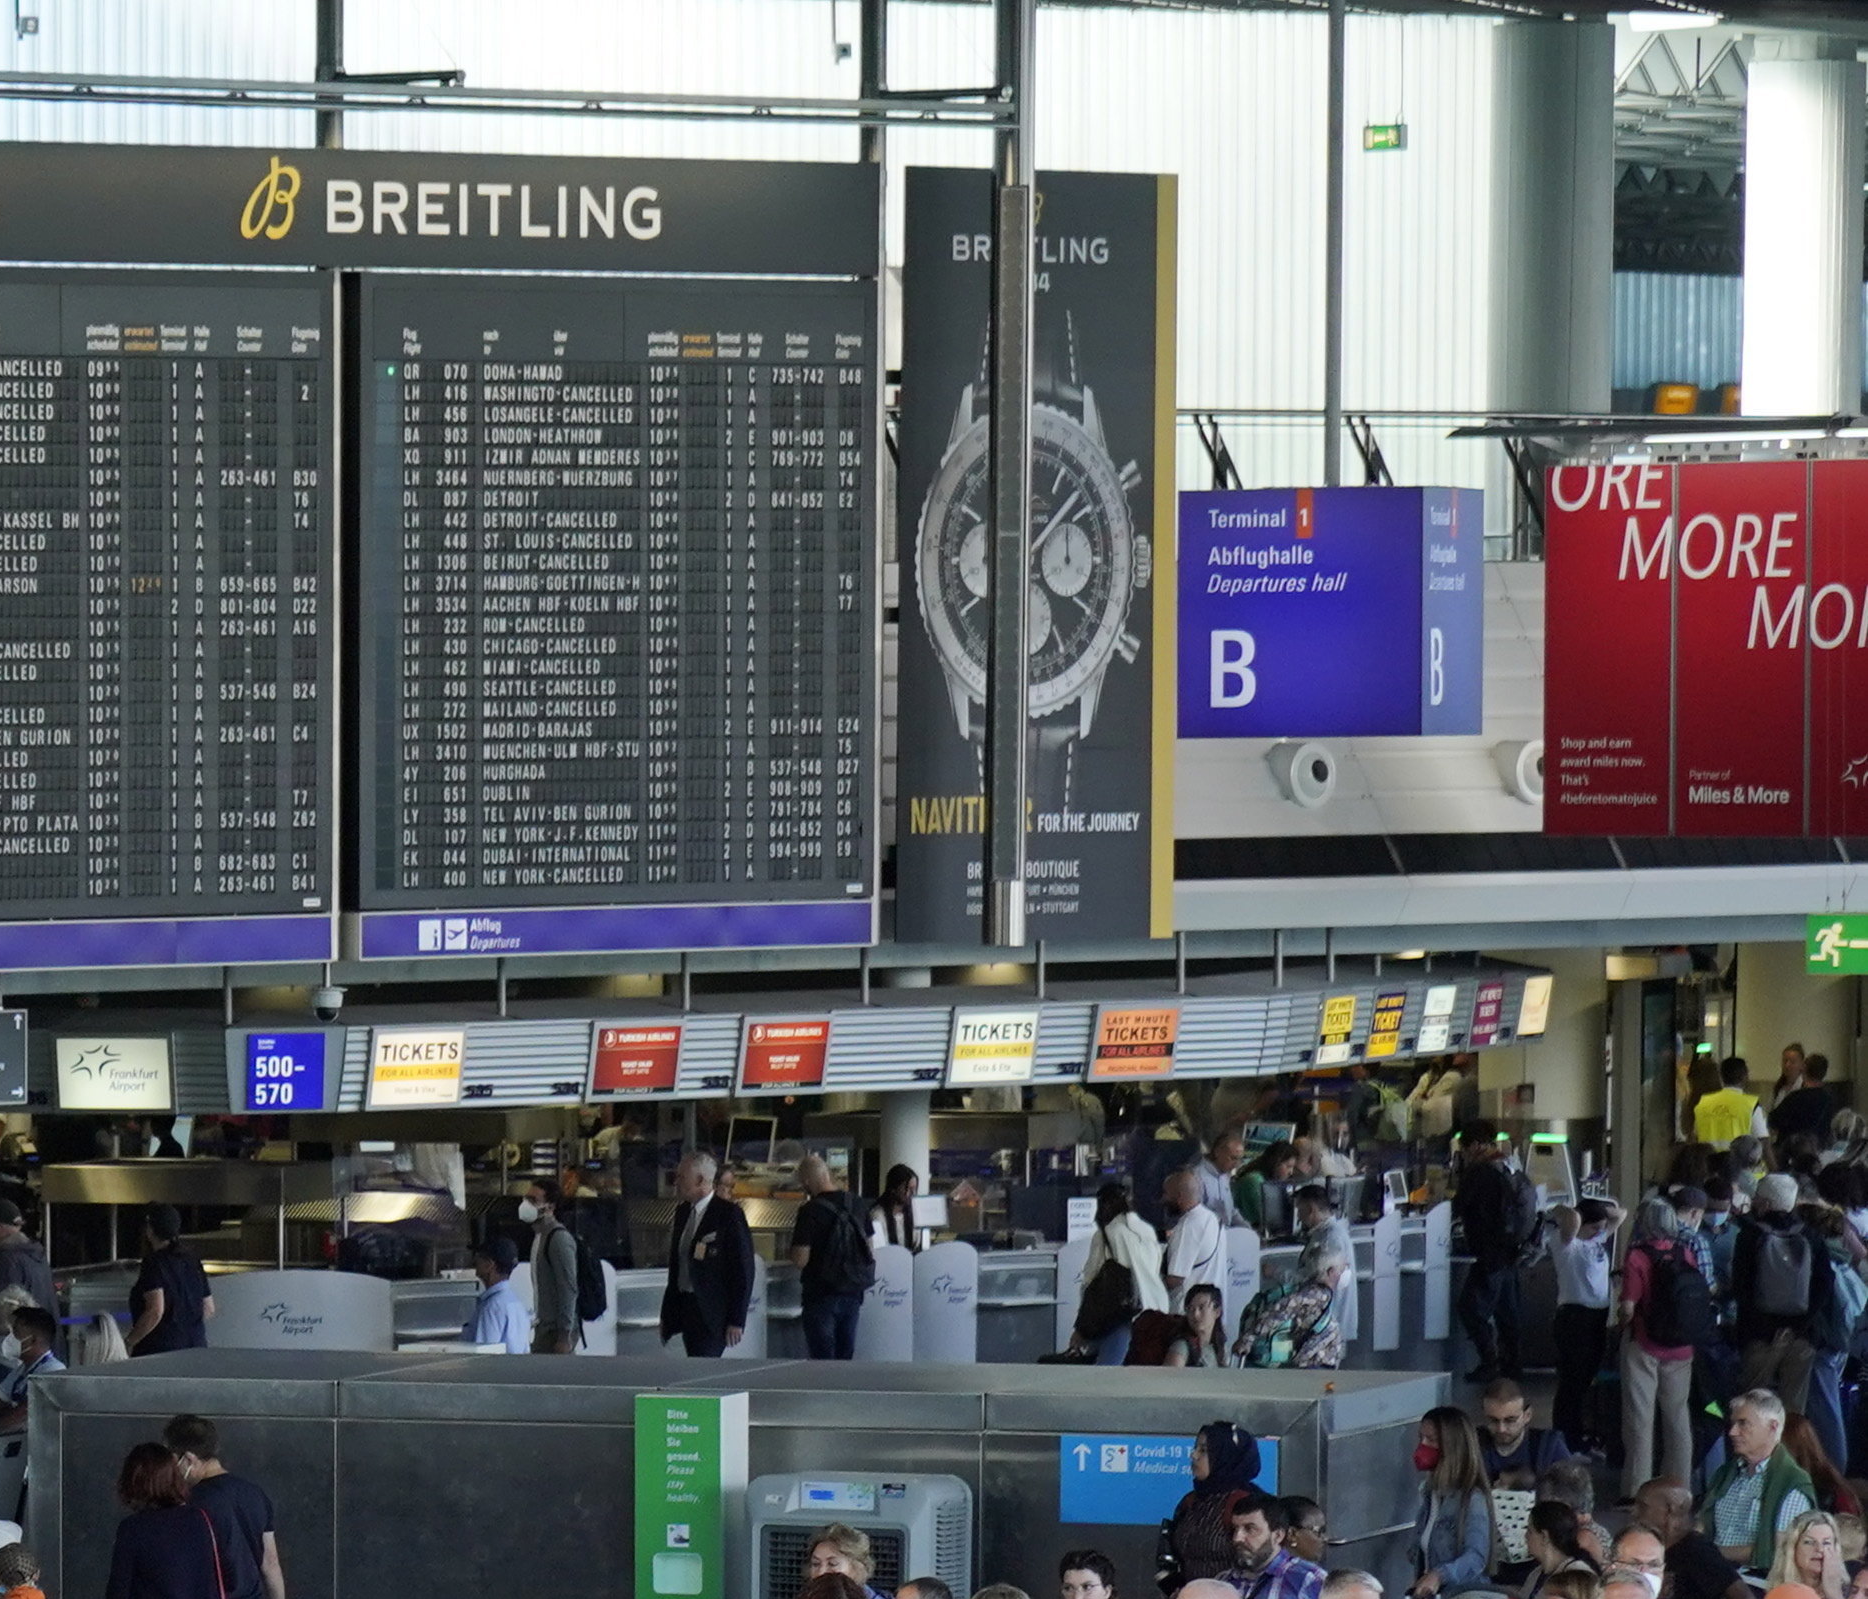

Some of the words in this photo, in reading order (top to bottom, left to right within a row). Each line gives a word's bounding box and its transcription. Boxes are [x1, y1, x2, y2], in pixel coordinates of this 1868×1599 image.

[327, 180, 661, 239] BREITLING
[953, 232, 1108, 267] BRLING
[404, 364, 419, 379] QR
[445, 364, 467, 379] 070
[484, 365, 562, 380] DOHA-HAMAD
[773, 368, 823, 383] 735-742
[1209, 509, 1285, 527] Terminal
[1300, 509, 1307, 526] 1
[1619, 510, 1797, 580] MORE
[1208, 546, 1313, 569] Abflughalle
[1208, 574, 1306, 596] Departures
[1312, 573, 1347, 591] hall
[1211, 630, 1256, 707] B
[1561, 738, 1585, 751] Shop
[1588, 737, 1606, 748] and
[1609, 740, 1631, 748] earn
[1560, 756, 1590, 767] award
[1593, 756, 1618, 766] miles
[1621, 758, 1642, 766] now.
[1562, 774, 1588, 785] That's
[1689, 770, 1720, 780] Partner
[1721, 770, 1730, 780] of
[1561, 793, 1657, 806] #beforetomatojuice
[1689, 786, 1730, 803] Miles
[1733, 787, 1744, 803] &
[1748, 786, 1789, 803] More
[1038, 814, 1060, 832] FOR
[1087, 813, 1139, 831] JOURNEY
[1026, 861, 1079, 878] BOUTIQUE
[470, 918, 501, 934] Abflug
[470, 936, 520, 951] Departures
[1106, 1017, 1129, 1025] LAST
[1135, 1015, 1170, 1023] MINUTE
[962, 1023, 1032, 1040] TICKETS
[1107, 1026, 1167, 1041] TICKETS
[382, 1043, 458, 1061] TICKETS
[995, 1044, 1030, 1055] AIRLINES
[110, 1068, 159, 1079] Frankfurt
[256, 1056, 304, 1077] 500-
[380, 1069, 397, 1078] FOR
[417, 1067, 454, 1075] AIRLINES
[110, 1081, 145, 1092] Airport
[256, 1083, 292, 1104] 570
[1135, 1445, 1182, 1457] Covid-19
[1134, 1461, 1178, 1473] Medical
